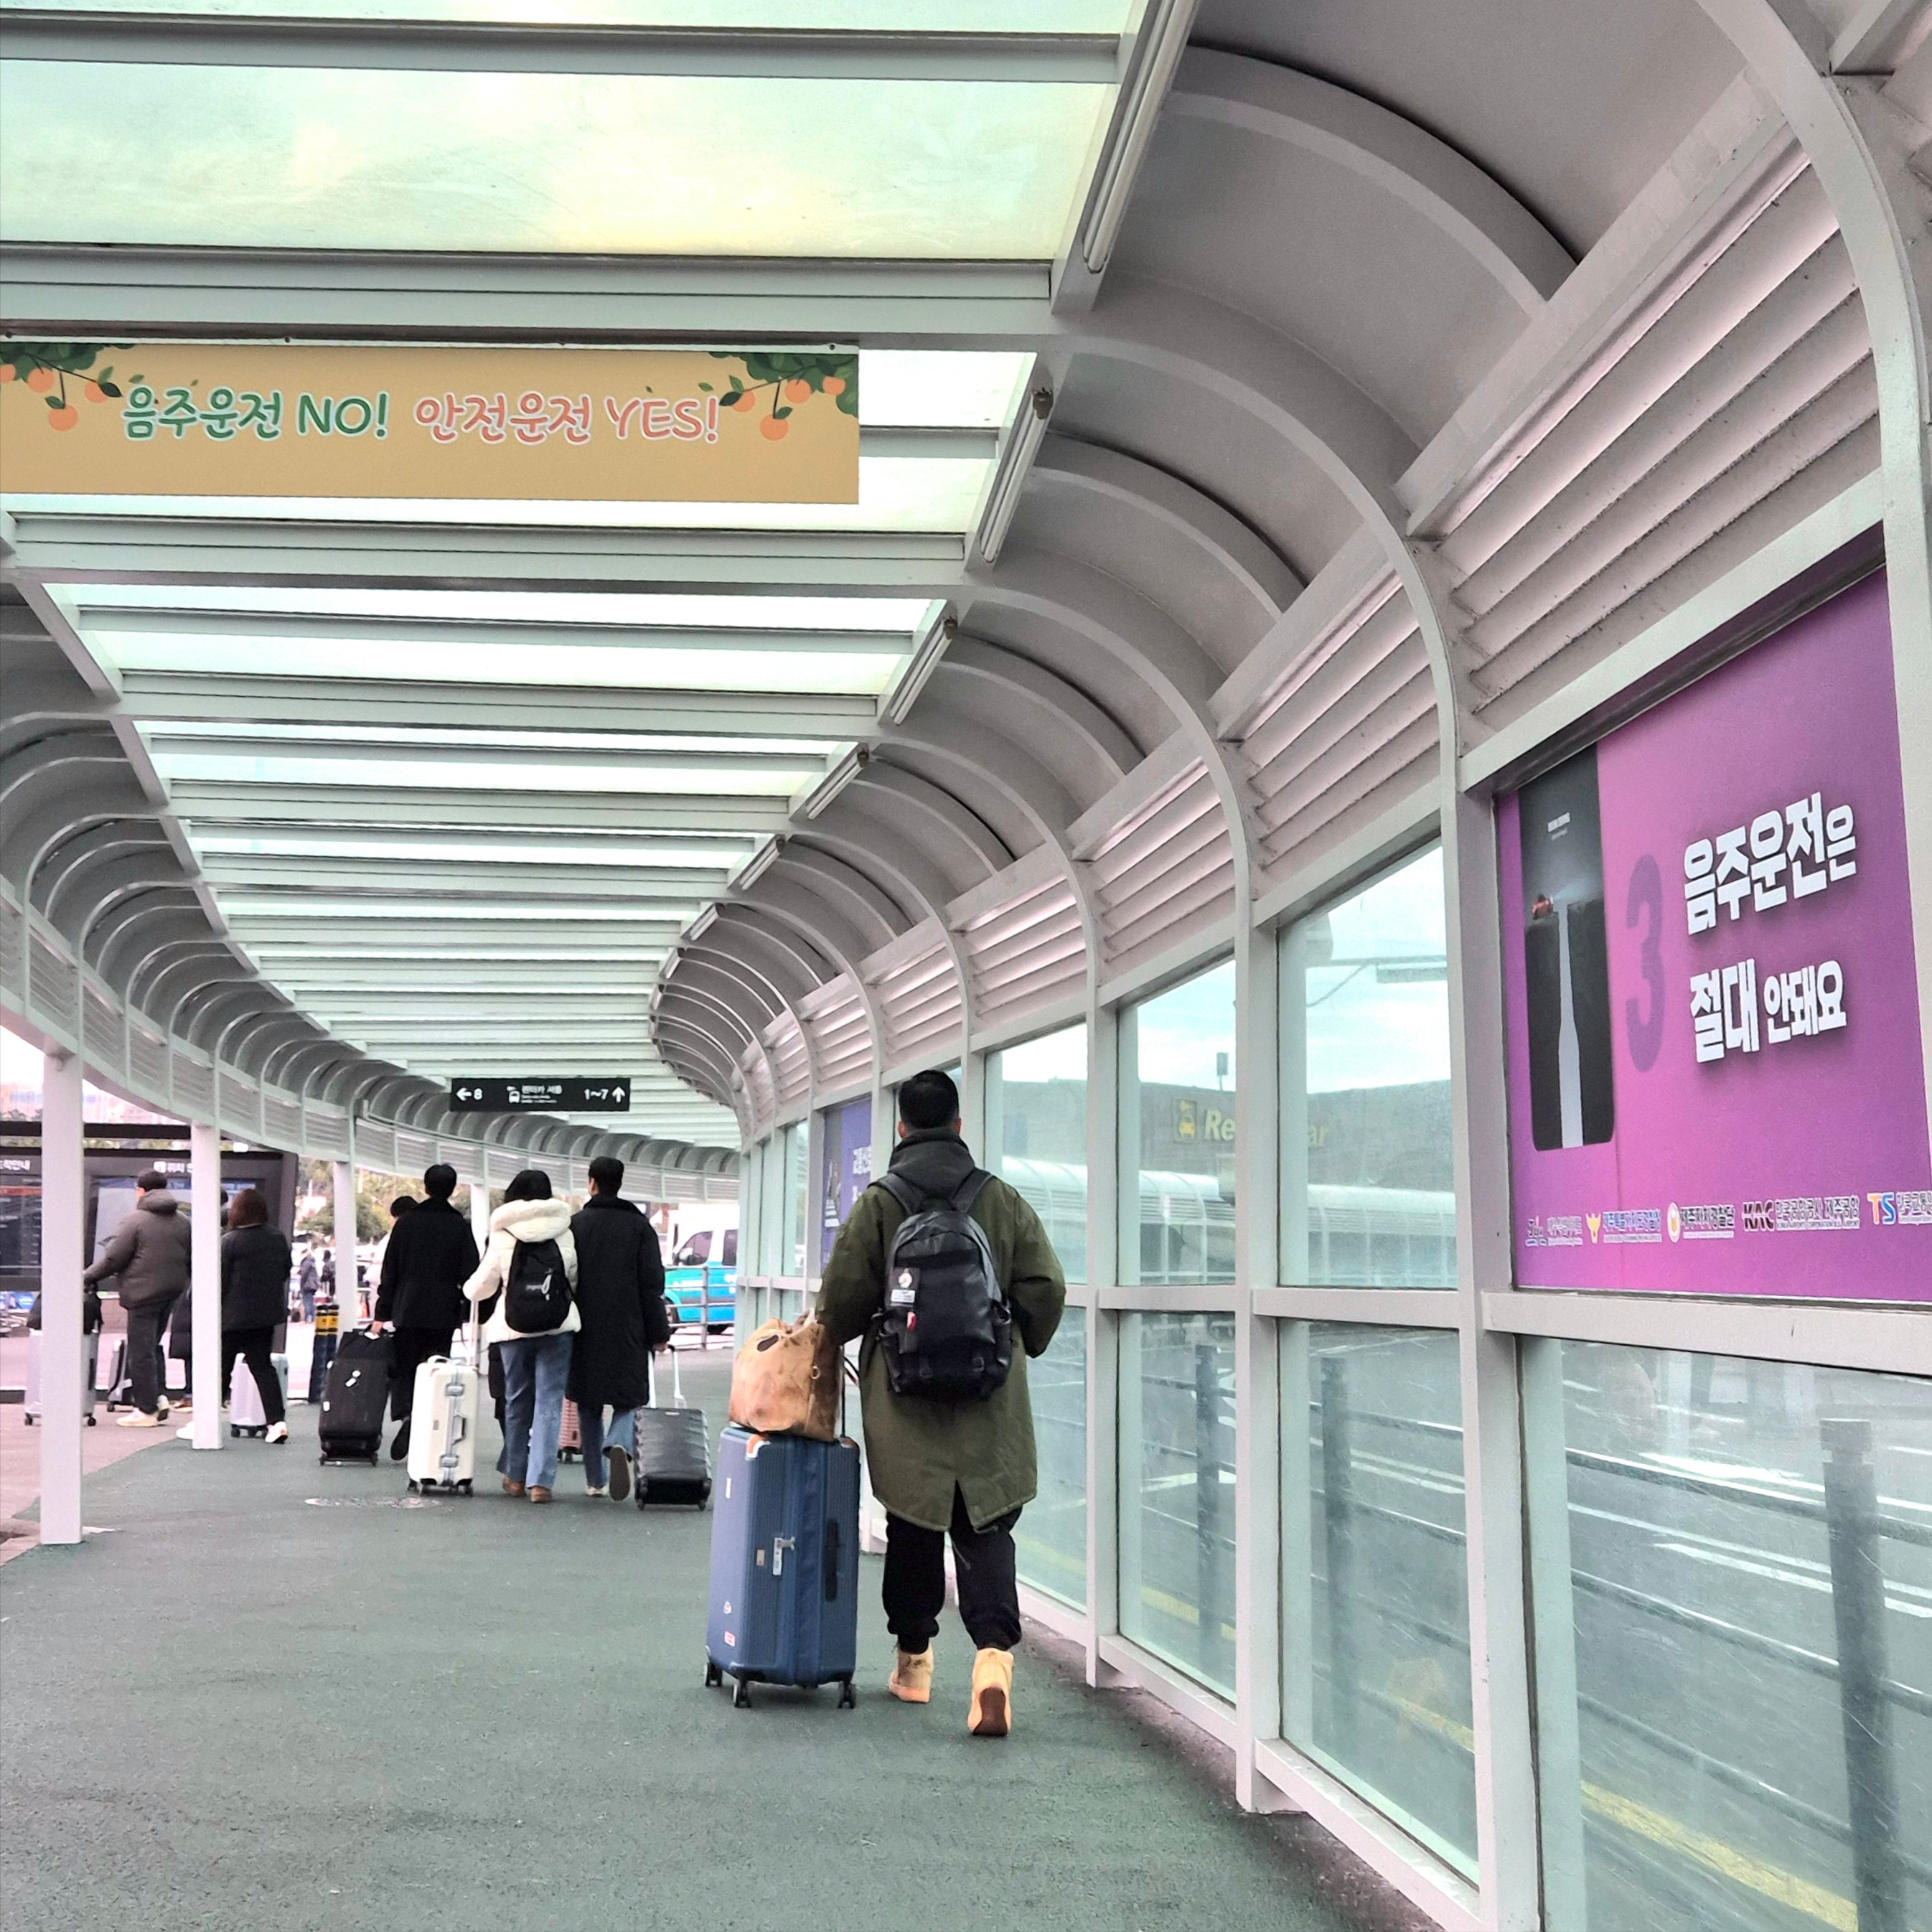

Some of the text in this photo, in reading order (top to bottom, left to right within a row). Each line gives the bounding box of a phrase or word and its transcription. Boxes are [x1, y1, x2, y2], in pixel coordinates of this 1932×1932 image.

[123, 386, 718, 445] 음주운전 NO! 안전운전 YES!
[1684, 791, 1857, 935] 음주운전은
[1689, 958, 1847, 1064] 절대 안돼요
[473, 1088, 483, 1100] 8
[584, 1088, 609, 1101] 1~7
[1742, 1199, 1775, 1232] KAC
[1867, 1192, 1896, 1225] TS
